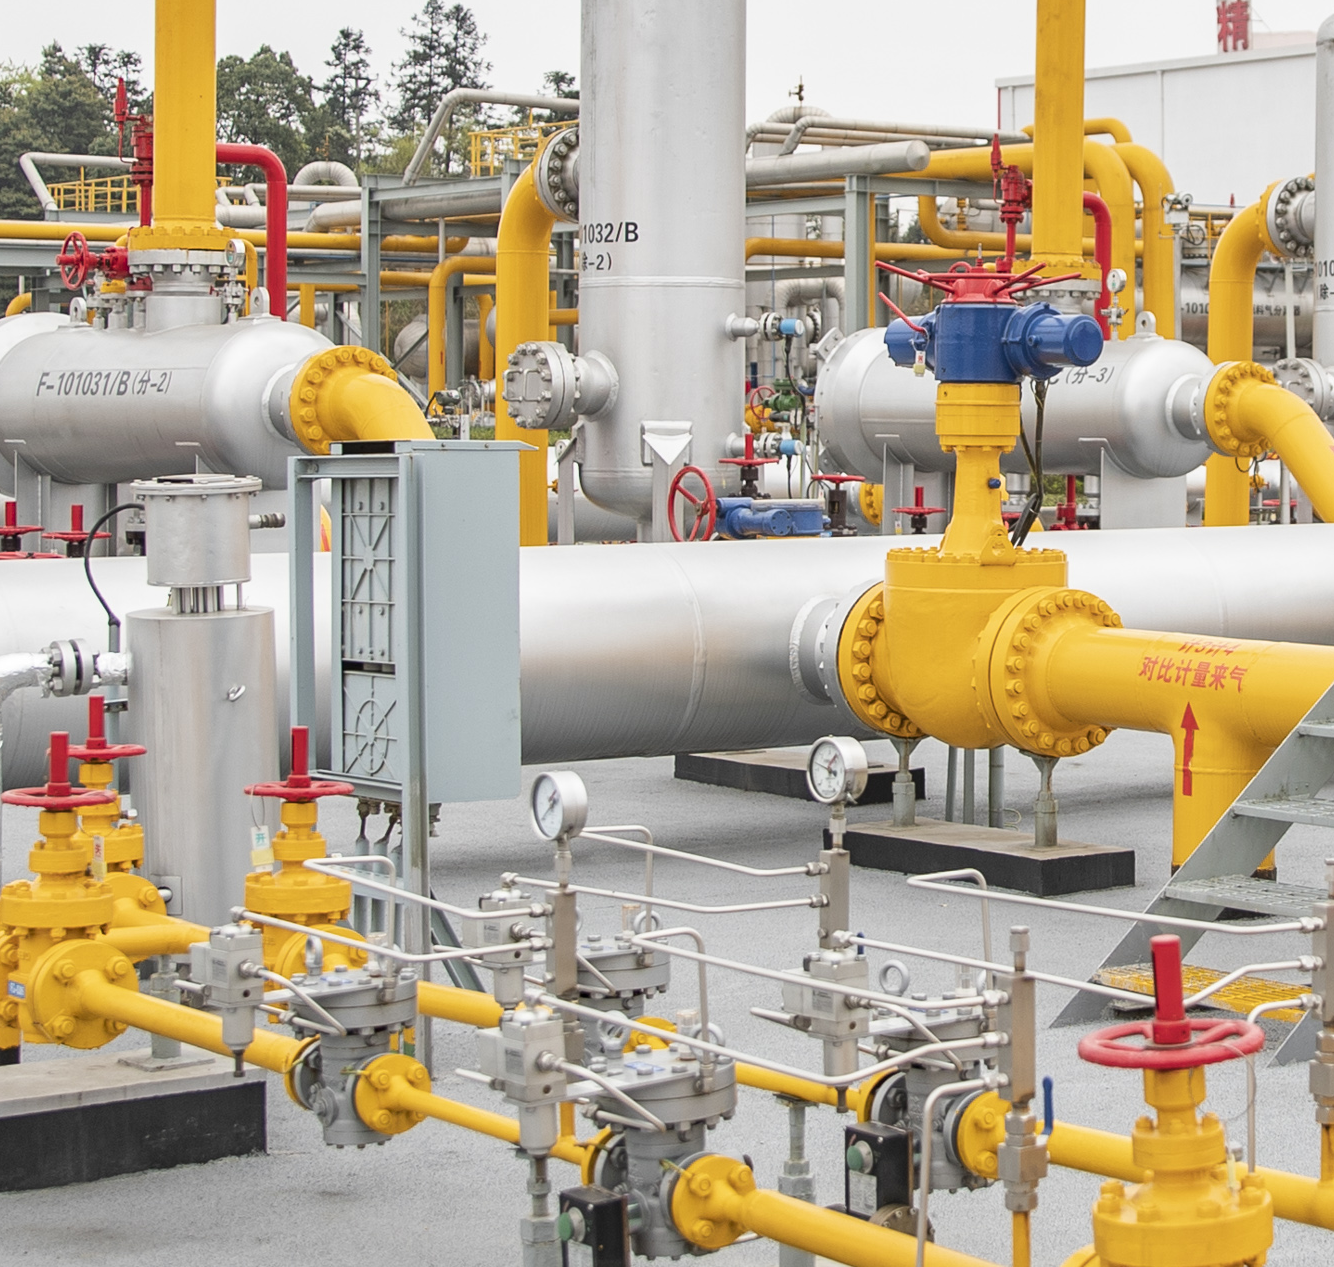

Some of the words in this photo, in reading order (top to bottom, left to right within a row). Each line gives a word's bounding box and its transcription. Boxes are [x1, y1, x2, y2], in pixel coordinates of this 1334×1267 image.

[1138, 655, 1248, 693] 对比计量来气
